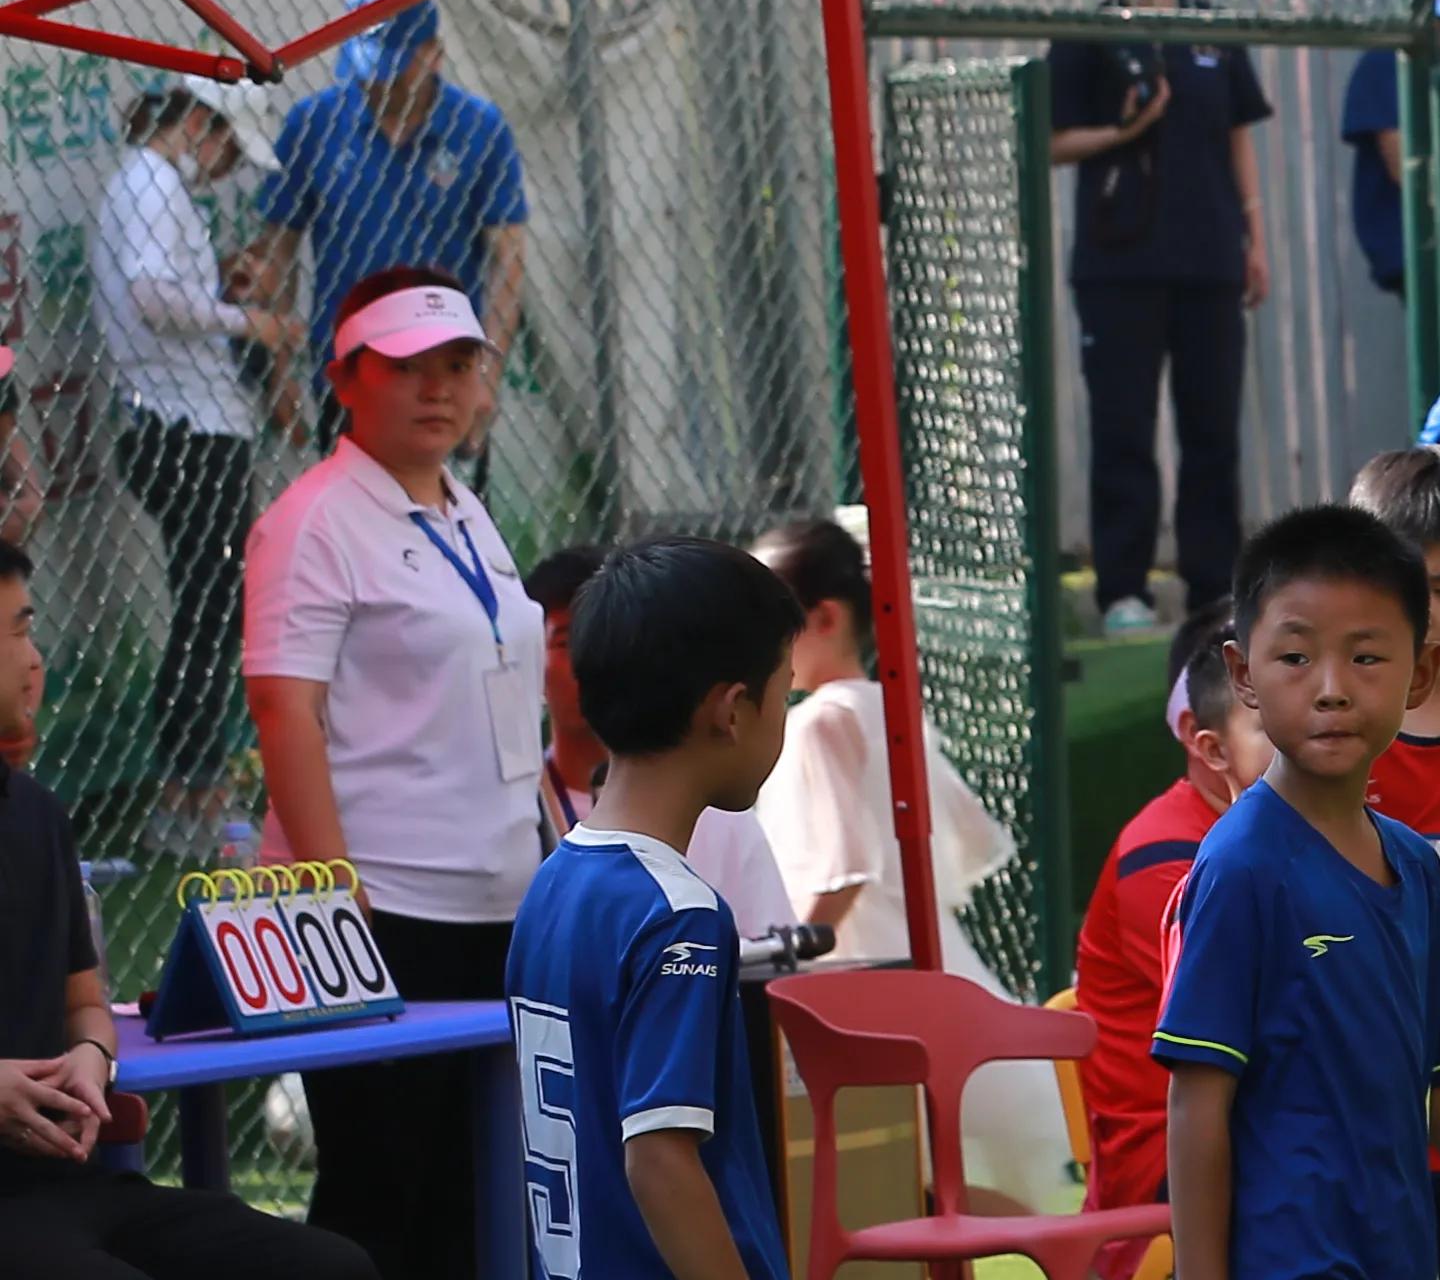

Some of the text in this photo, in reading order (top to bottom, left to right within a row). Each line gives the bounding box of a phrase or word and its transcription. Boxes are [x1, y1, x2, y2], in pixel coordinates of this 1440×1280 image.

[216, 908, 386, 1010] 00 00
[660, 963, 718, 977] SUNAIS
